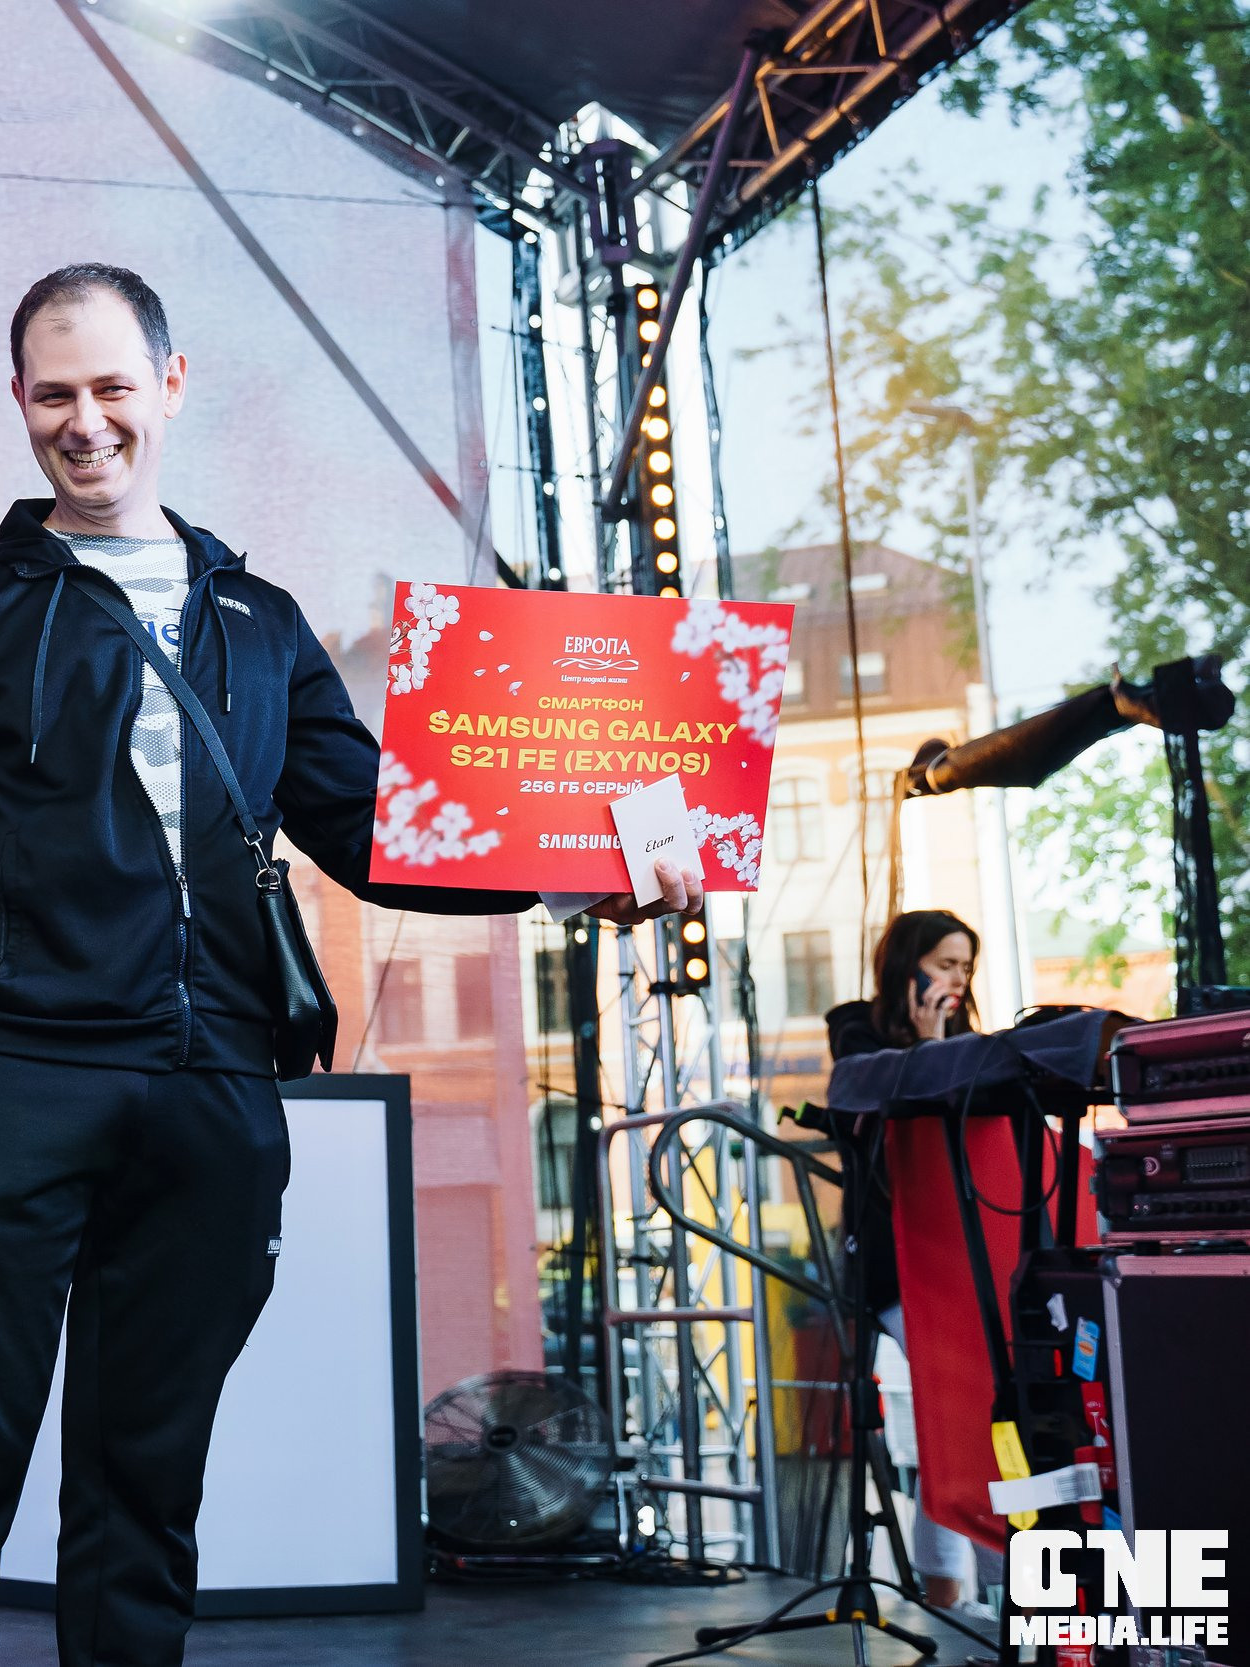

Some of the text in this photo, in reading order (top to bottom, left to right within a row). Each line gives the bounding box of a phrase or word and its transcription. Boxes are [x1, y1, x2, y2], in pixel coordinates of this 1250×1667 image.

[564, 636, 631, 656] ЕВРОПА
[561, 674, 582, 684] Центр
[538, 696, 644, 712] СМАРТФОН
[428, 711, 738, 745] SAMSUNG GALAXY
[450, 744, 710, 776] S21 FE (EXYNOS)
[520, 780, 644, 795] 256 ГБ СЕРЫЙ
[646, 835, 674, 852] Etam
